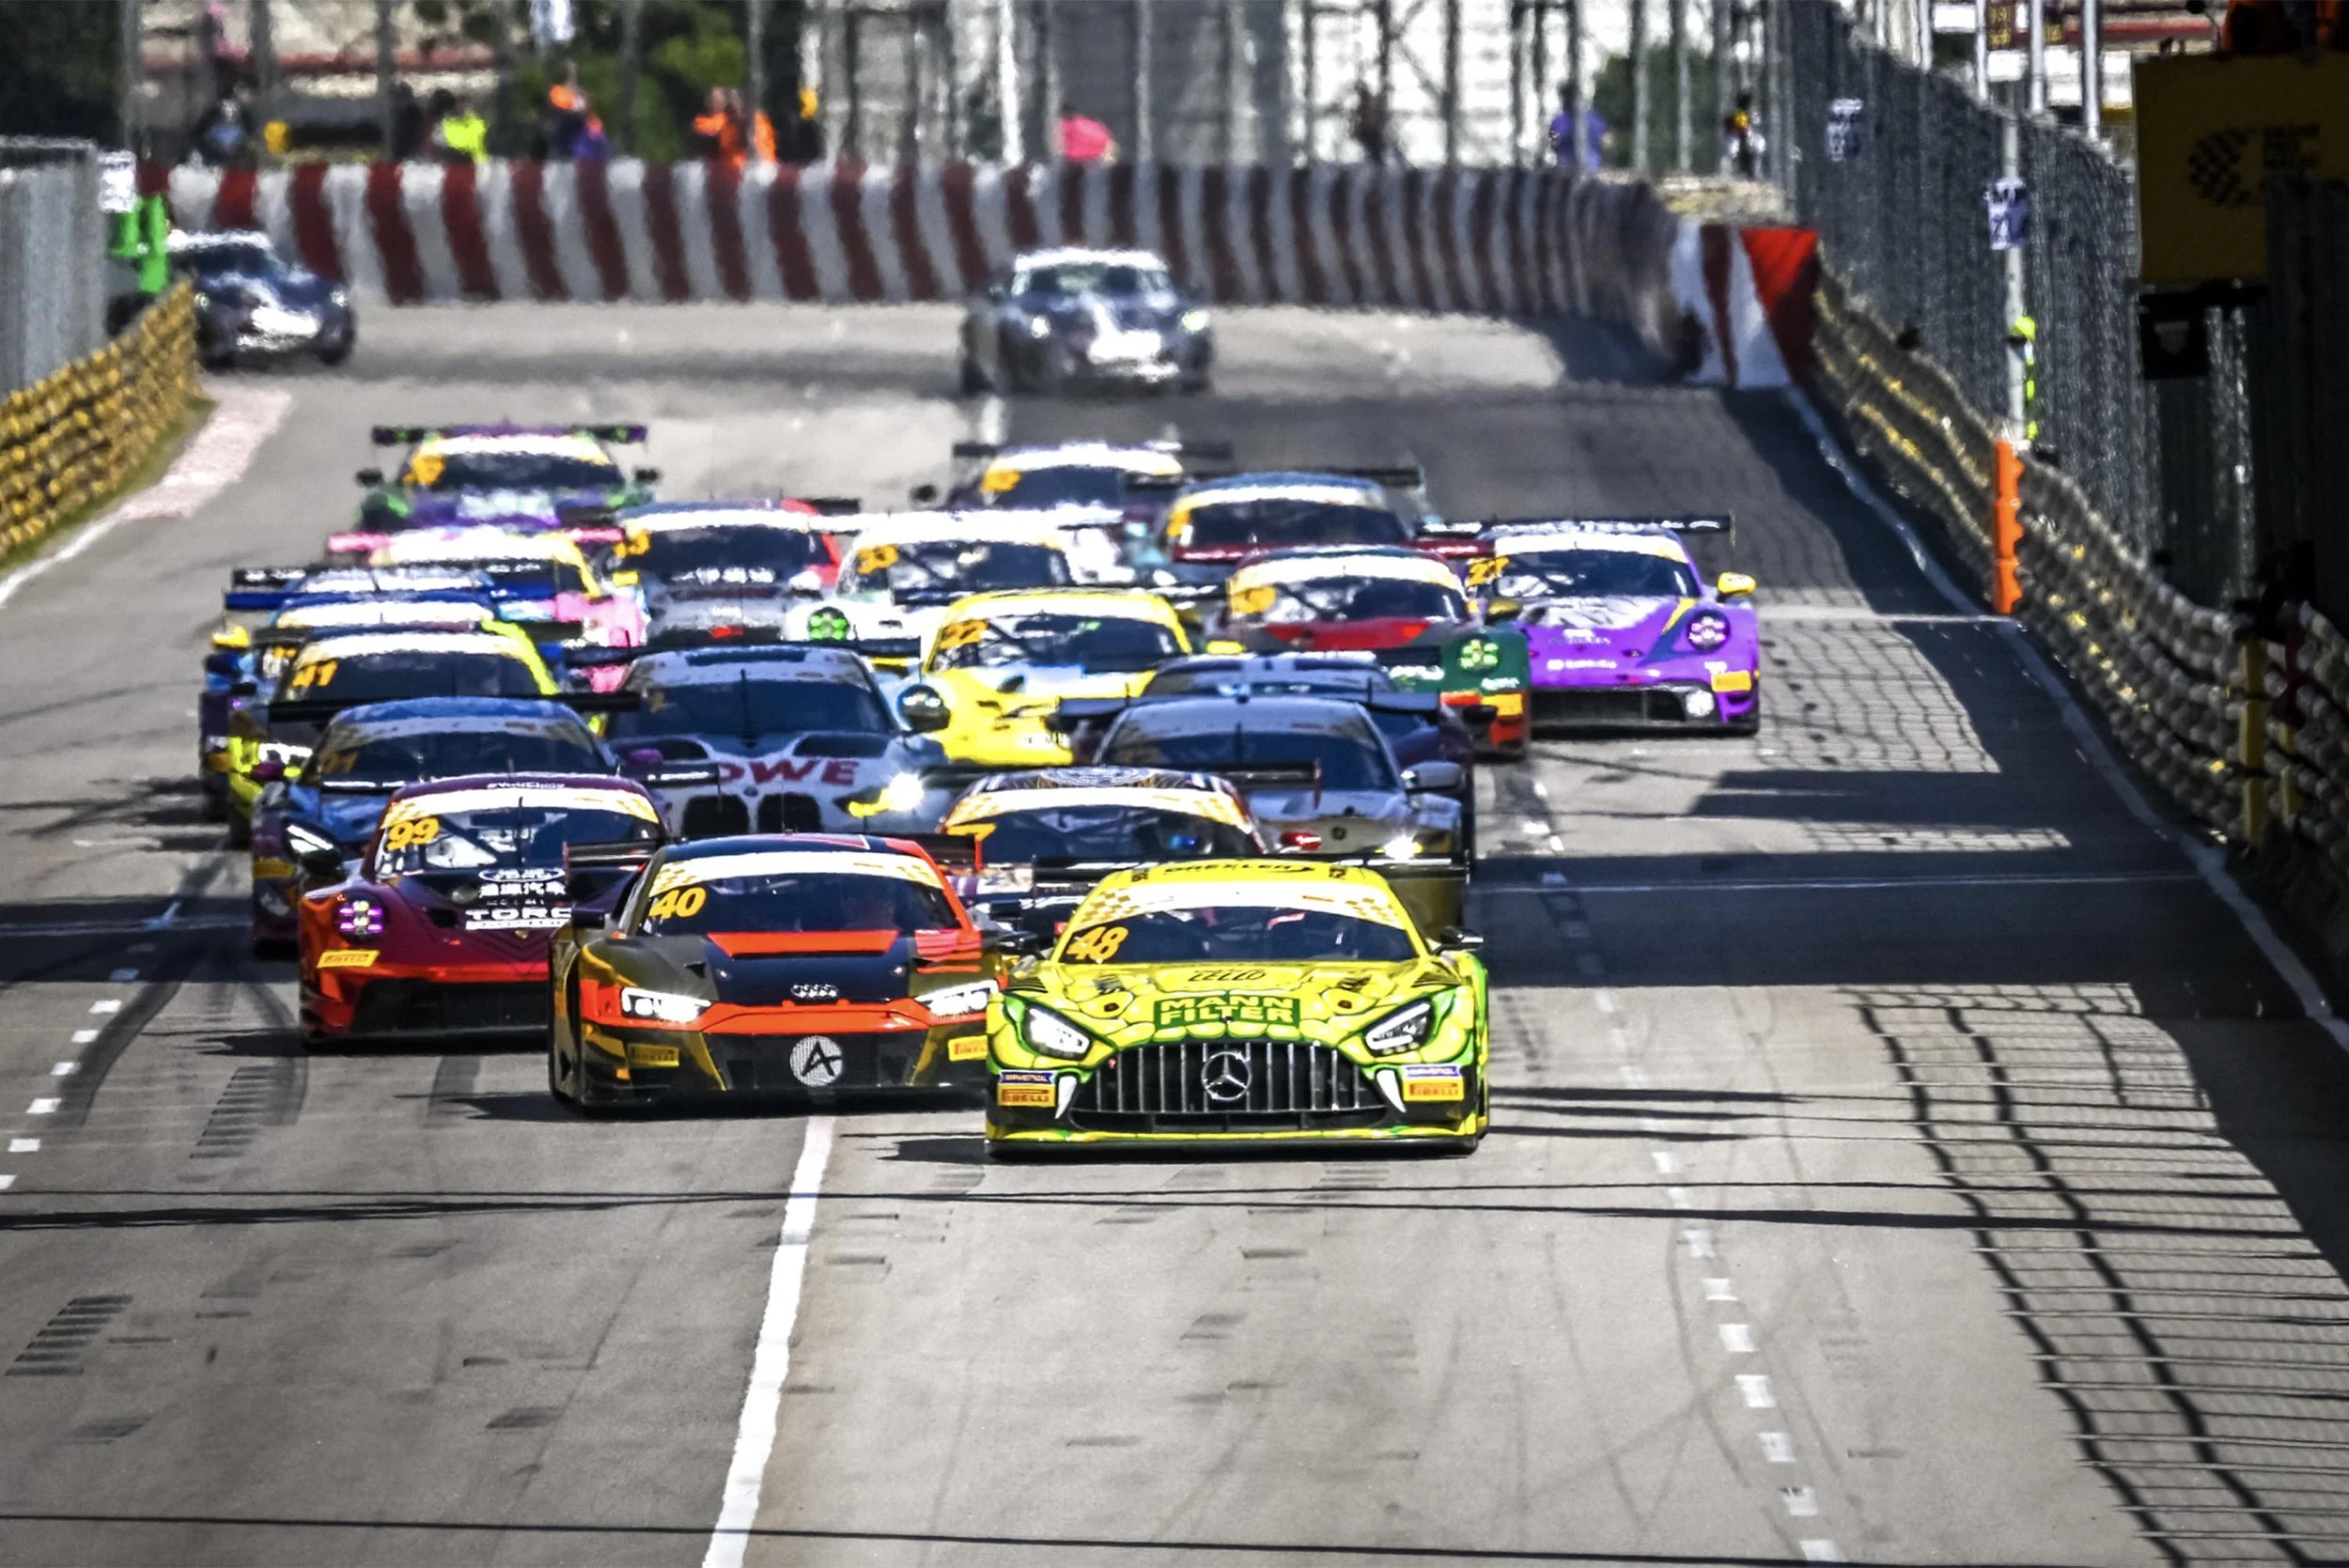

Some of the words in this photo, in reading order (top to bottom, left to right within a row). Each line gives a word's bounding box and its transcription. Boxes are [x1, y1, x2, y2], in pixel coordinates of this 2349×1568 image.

[719, 759, 859, 786] OWE
[385, 816, 440, 851] 99
[648, 887, 707, 920] 40
[1066, 926, 1129, 961] 48
[1160, 995, 1294, 1010] MANN
[1160, 1005, 1294, 1026] FILTER
[1001, 1088, 1050, 1103] PIRELLI
[1408, 1082, 1458, 1096] PIRELLI
